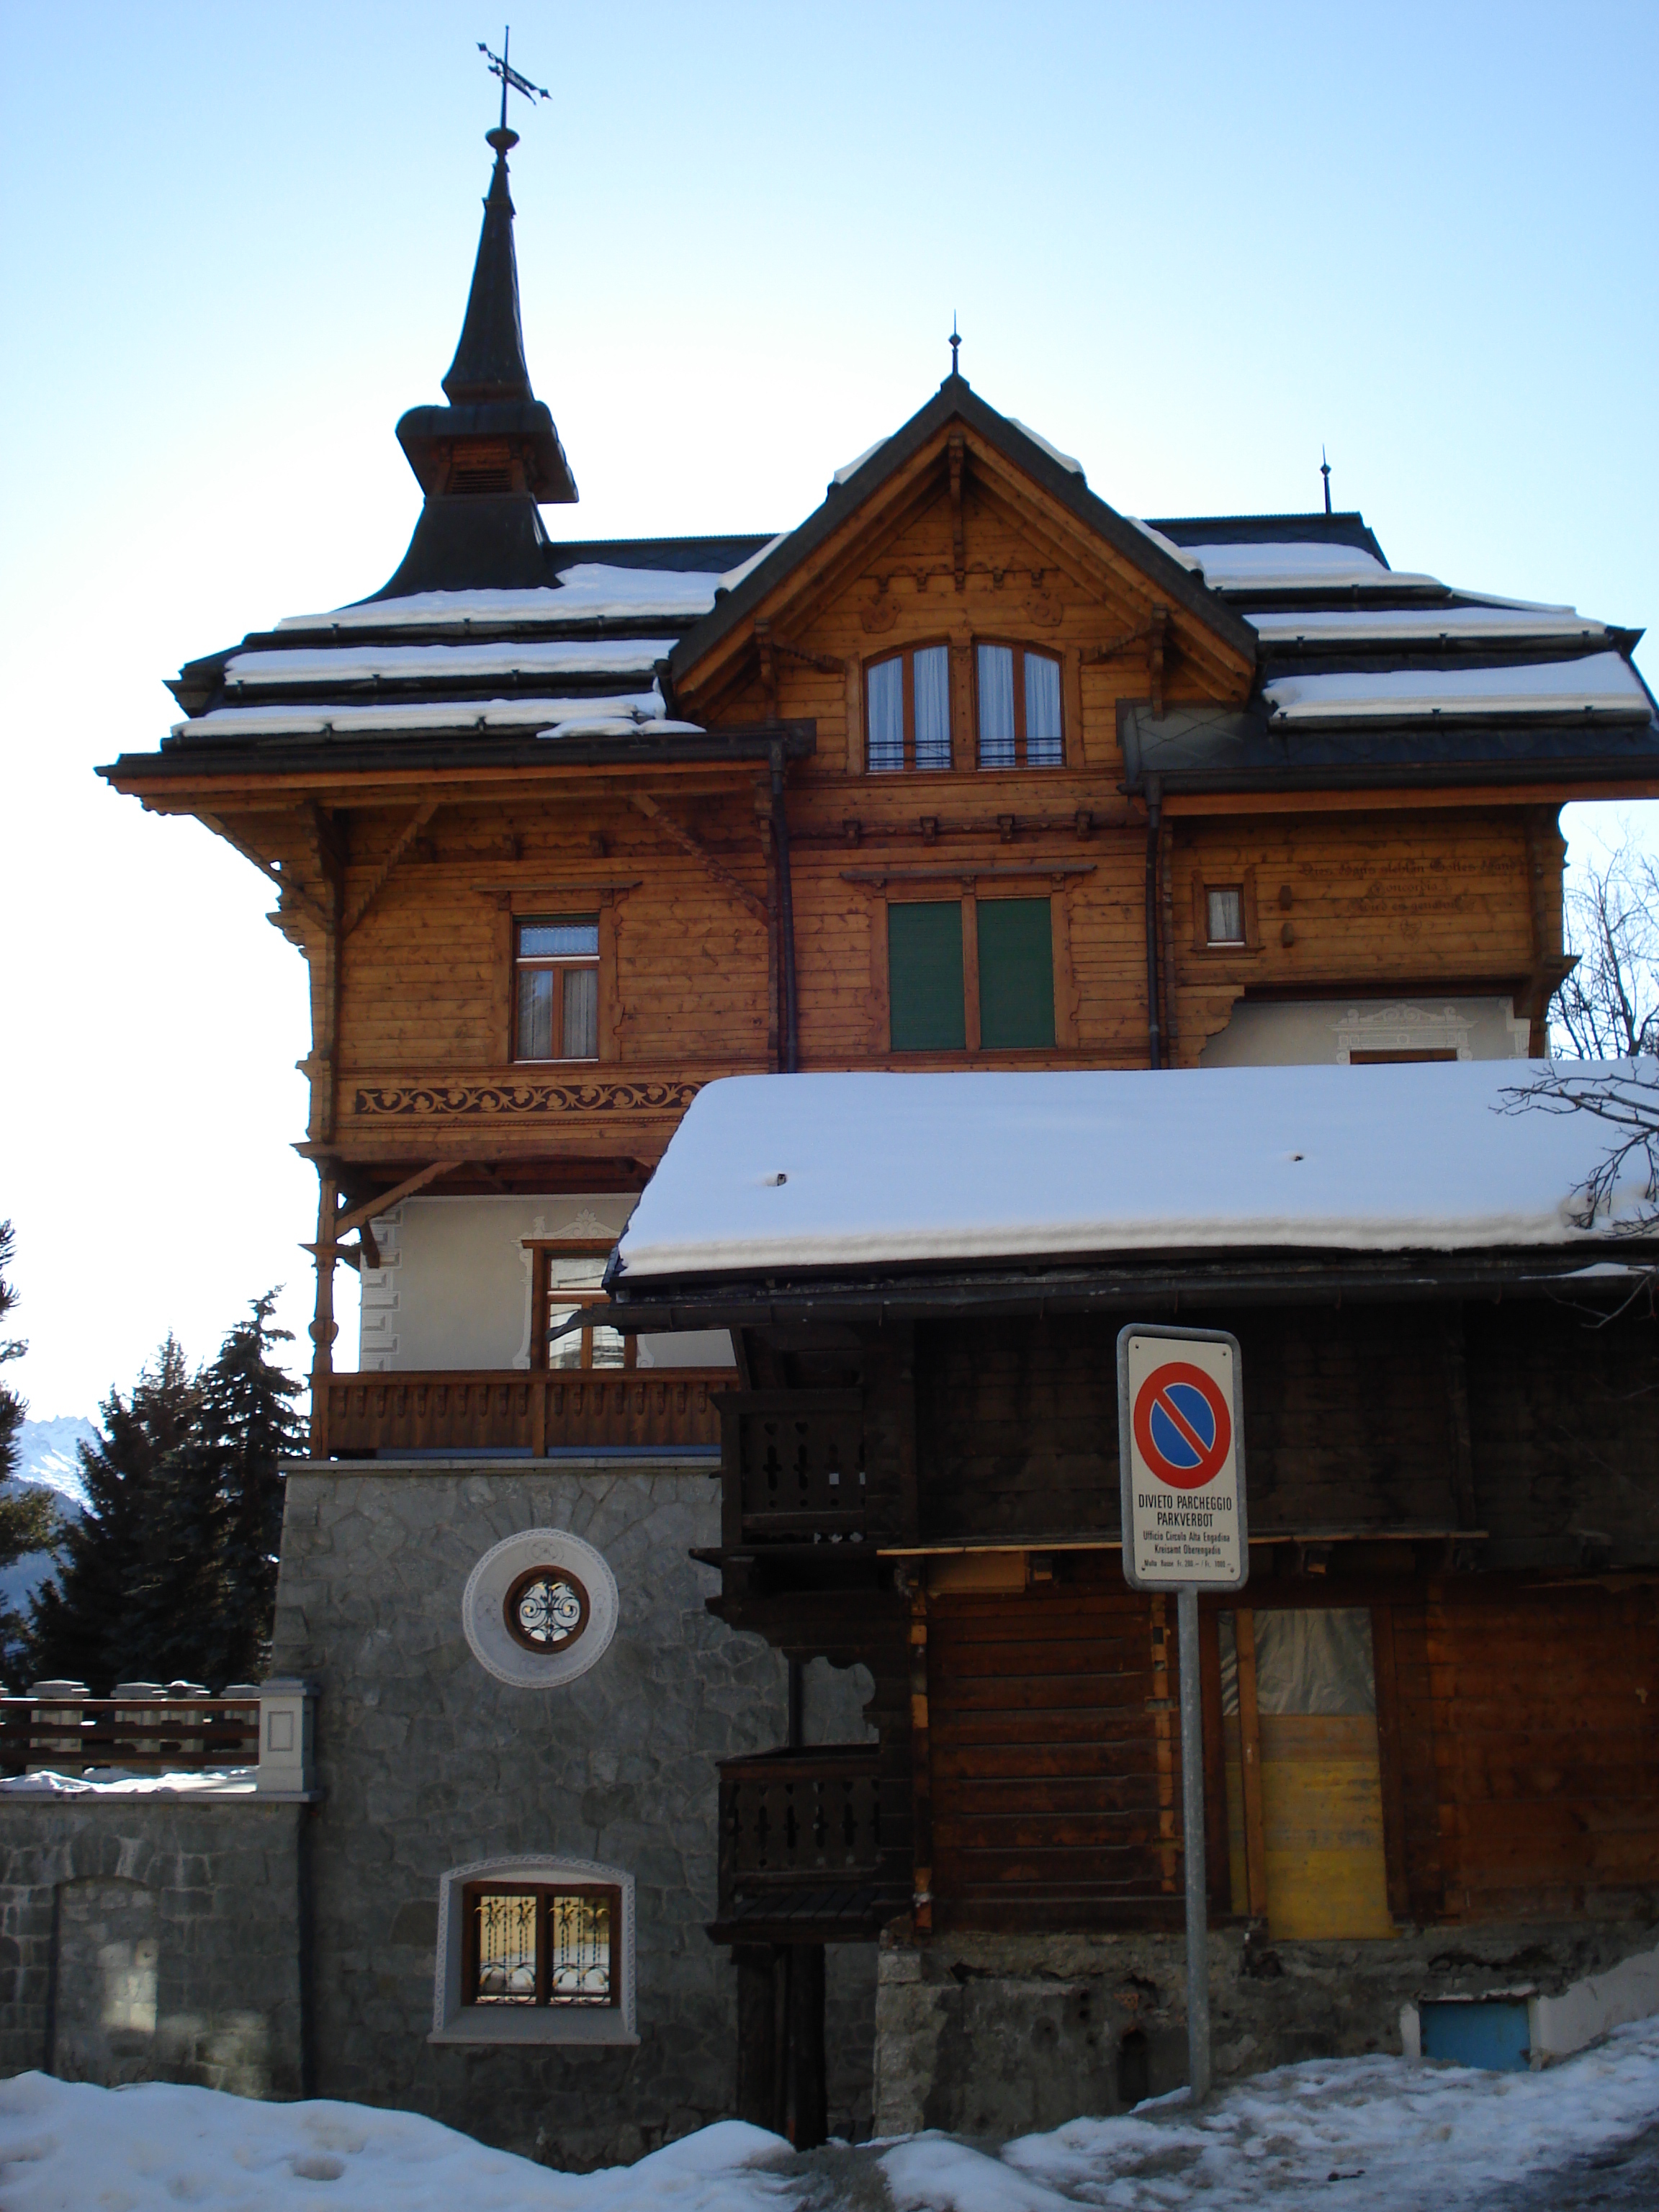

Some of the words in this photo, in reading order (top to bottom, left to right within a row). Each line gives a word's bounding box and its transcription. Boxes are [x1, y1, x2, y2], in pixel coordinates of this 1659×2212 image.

[1138, 1494, 1173, 1509] DIVIETO
[1177, 1496, 1232, 1511] PARCHEGGIO
[1157, 1512, 1213, 1527] PARKVERBOT
[1143, 1531, 1164, 1541] Ufficio
[1166, 1531, 1187, 1542] Circolo
[1189, 1532, 1201, 1542] Alta
[1203, 1532, 1230, 1545] Engadina
[1154, 1545, 1181, 1555] Kreisamt
[1184, 1545, 1220, 1557] Oberengadin
